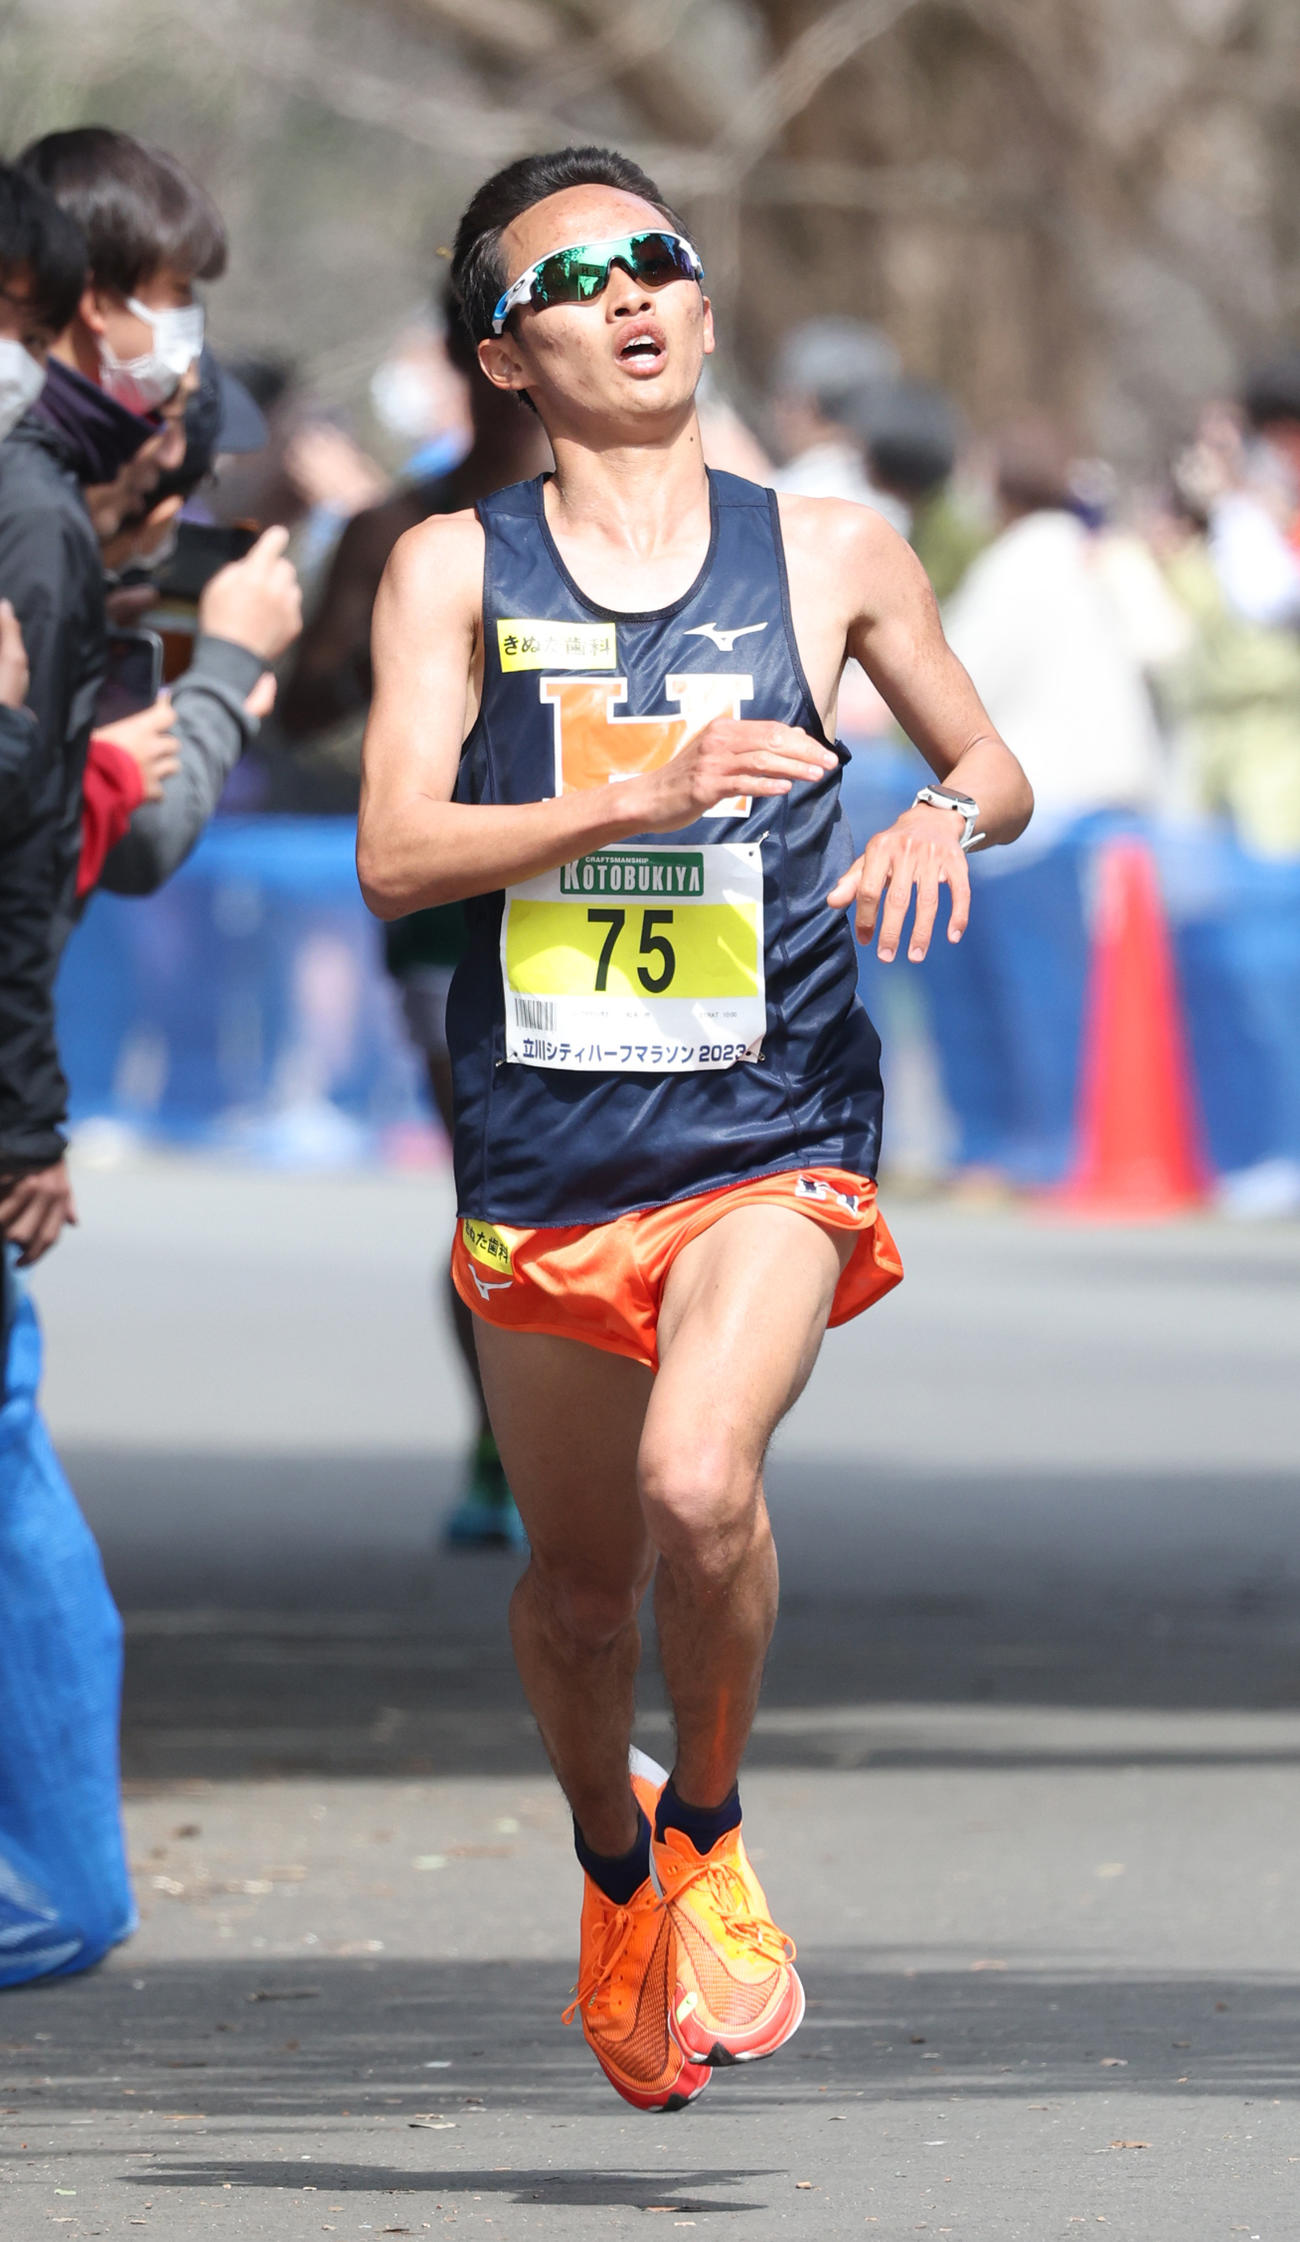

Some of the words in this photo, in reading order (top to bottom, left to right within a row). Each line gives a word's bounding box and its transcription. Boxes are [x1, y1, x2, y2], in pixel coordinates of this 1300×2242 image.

[503, 635, 610, 657] きぬた歯科
[584, 856, 650, 864] CRAFTSMANSHIP
[564, 859, 700, 892] KOTOBUKIYA
[587, 908, 676, 993] 75
[523, 1038, 694, 1064] 立川シティハーフマラソン
[699, 1043, 747, 1062] 2023
